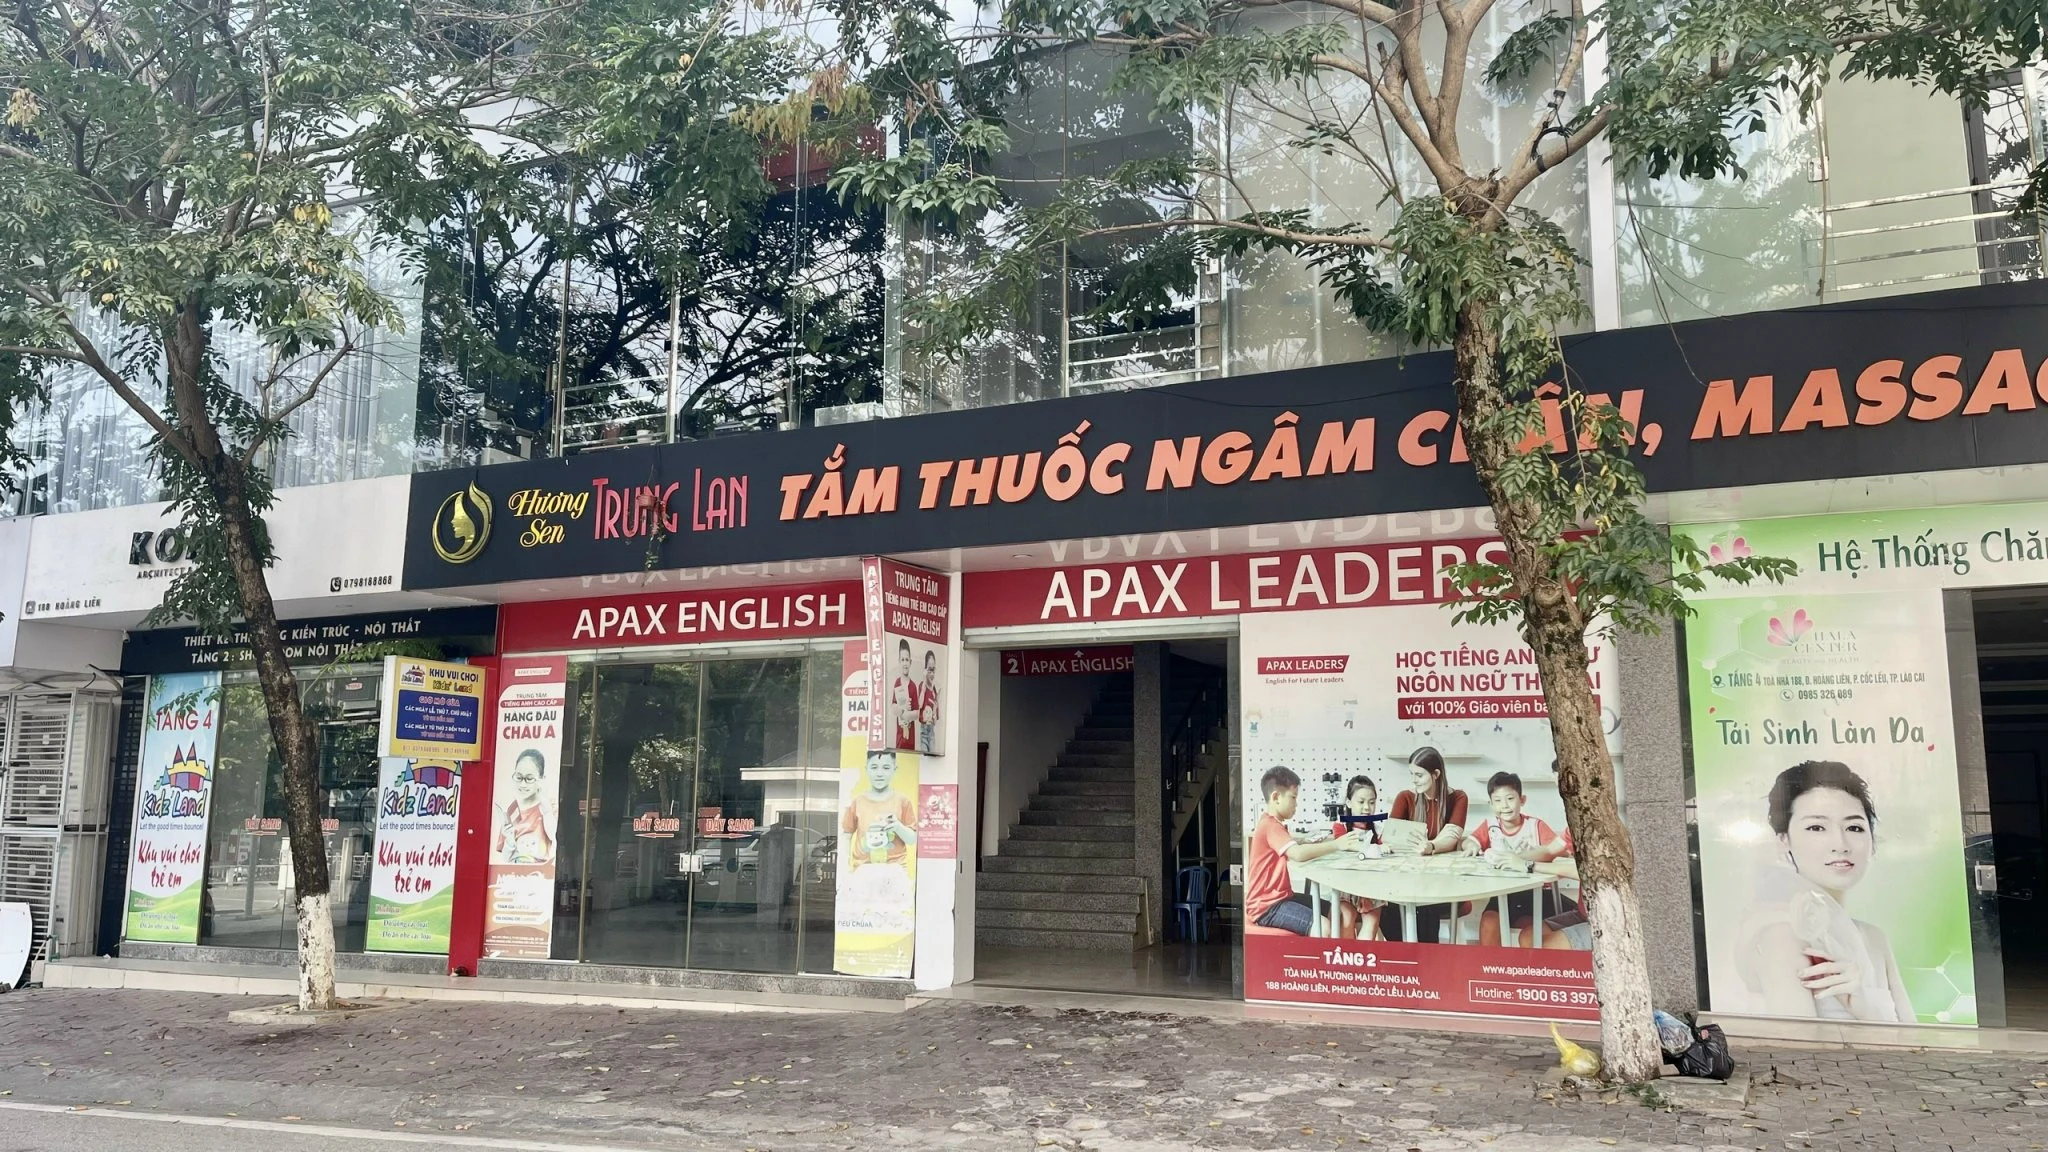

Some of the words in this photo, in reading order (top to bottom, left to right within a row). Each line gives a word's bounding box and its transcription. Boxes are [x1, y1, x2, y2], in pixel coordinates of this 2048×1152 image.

[780, 443, 899, 521] TẮM
[918, 418, 1133, 510] THUỐC
[1145, 410, 1376, 491] NGÂM
[592, 478, 680, 540] TRUNG
[692, 467, 748, 532] LAN
[519, 518, 566, 548] Sen
[1818, 538, 1862, 579] Hệ
[1872, 528, 1968, 575] Thống
[1980, 527, 2048, 563] Chă
[895, 570, 921, 593] TRUNG
[922, 575, 939, 597] TÂM
[1040, 563, 1188, 619] APAX
[867, 565, 880, 622] APAX
[572, 603, 668, 640] APAX
[677, 593, 847, 634] ENGLISH
[892, 610, 912, 630] APAX
[912, 616, 941, 637] ENGLISH
[291, 623, 317, 641] KIẾN
[321, 623, 351, 638] TRÚC
[363, 620, 386, 637] NỘI
[391, 616, 422, 634] THẤT
[307, 643, 329, 658] NỘI
[1396, 651, 1436, 672] HỌC
[1439, 642, 1499, 667] TIẾNG
[1007, 658, 1019, 674] 2
[1031, 660, 1067, 673] APAX
[1071, 656, 1134, 672] ENGLISH
[1266, 660, 1293, 671] APAX
[1295, 659, 1344, 670] LEADERS
[429, 668, 446, 679] KHU
[446, 670, 459, 680] VUI
[1265, 677, 1287, 685] English
[1396, 671, 1455, 693] NGÔN
[1460, 669, 1507, 692] NGỮ
[1755, 673, 1761, 686] 4
[1913, 672, 1926, 682] CAI
[1798, 689, 1818, 699] 0985
[1820, 689, 1836, 699] 326
[1837, 689, 1853, 699] 089
[1405, 702, 1425, 715] với
[1428, 700, 1466, 715] 100%
[1469, 700, 1499, 714] Giáo
[1502, 700, 1531, 713] viên
[202, 709, 212, 730] 4
[1715, 718, 1751, 745] Tái
[1762, 718, 1818, 745] Sinh
[1831, 717, 1876, 744] Làn
[1888, 716, 1925, 744] Da
[379, 821, 389, 830] Let
[389, 822, 399, 830] the
[399, 822, 415, 831] good
[415, 822, 432, 830] times
[653, 818, 680, 832] SANG
[727, 818, 755, 832] SANG
[378, 840, 401, 867] Khu
[405, 844, 426, 867] vui
[167, 872, 183, 888] em
[415, 875, 432, 893] em
[1323, 945, 1364, 966] TẦNG
[1366, 953, 1377, 967] 2
[1300, 968, 1318, 979] NHÀ
[1318, 970, 1353, 981] THƯƠNG
[1355, 973, 1370, 984] MẠI
[1371, 973, 1400, 984] TRUNG
[1401, 976, 1421, 986] LAN,
[1482, 965, 1594, 980] www.apaxleaders.edu.vn
[1265, 981, 1280, 990] 188
[1281, 980, 1309, 992] HOÀNG
[1331, 984, 1367, 995] PHƯỜNG
[1406, 988, 1423, 999] LÀO
[1475, 987, 1514, 999] Hotline:
[1516, 988, 1548, 1001] 1900
[1550, 990, 1567, 1002] 63
